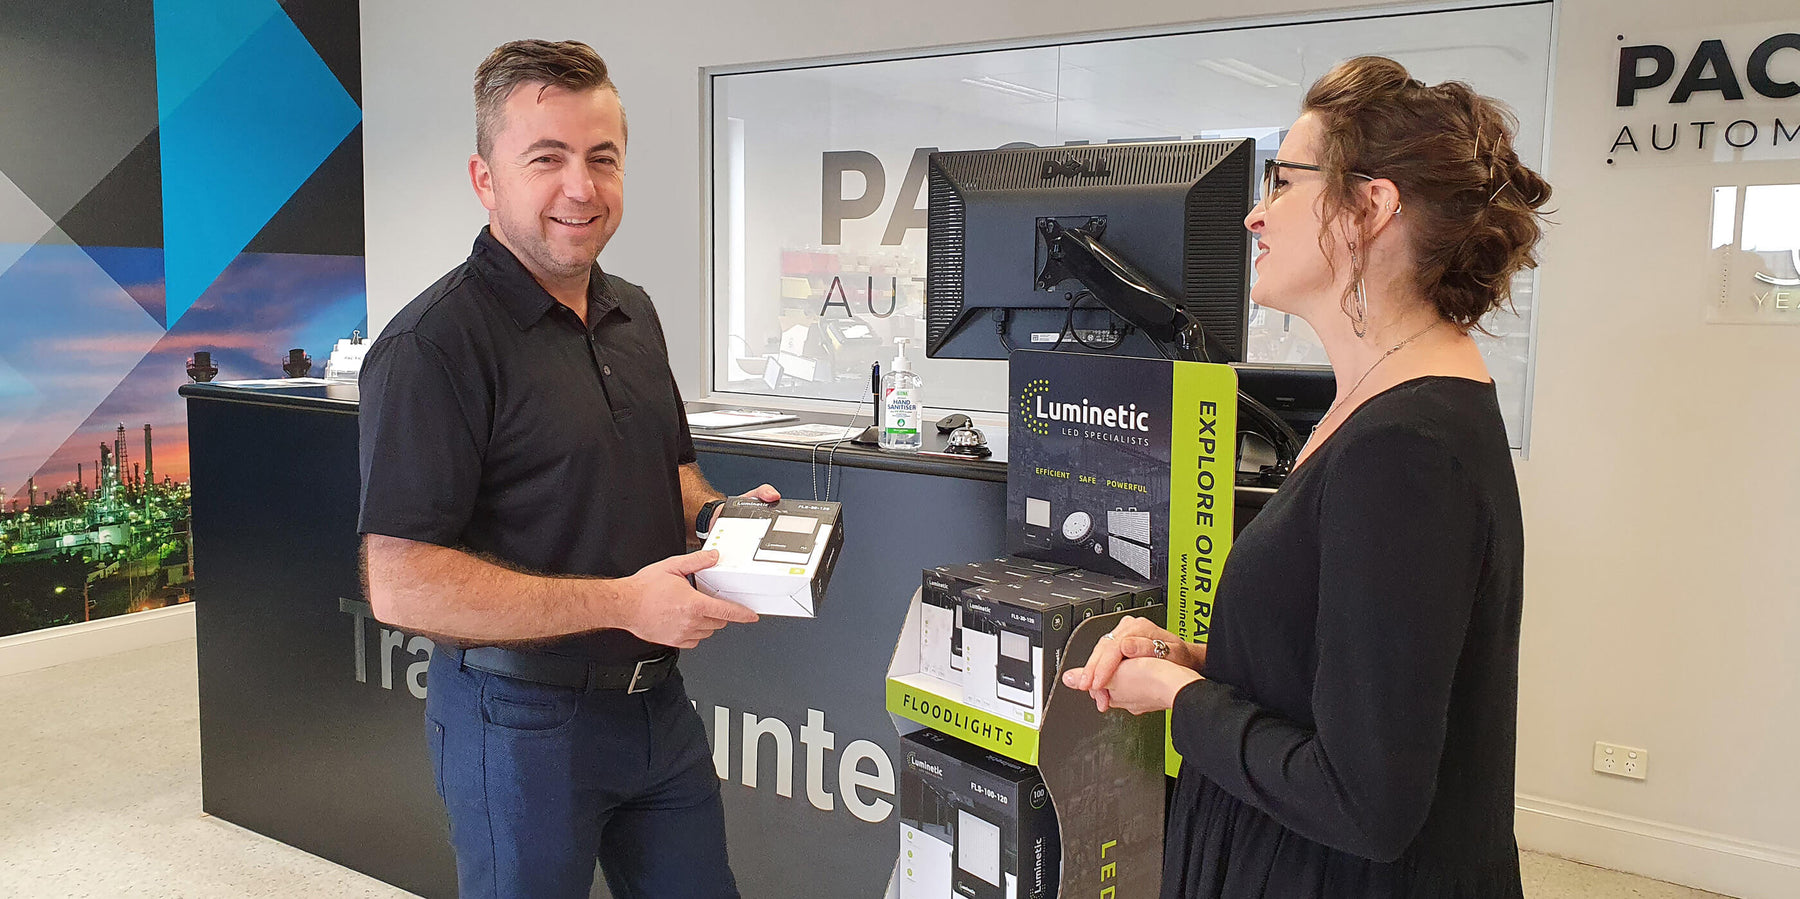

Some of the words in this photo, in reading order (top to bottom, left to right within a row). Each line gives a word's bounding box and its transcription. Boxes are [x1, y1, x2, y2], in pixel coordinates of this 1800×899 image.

[1616, 33, 1800, 107] PAC
[1609, 118, 1800, 153] AUTOM
[1041, 158, 1111, 180] DELL
[1753, 291, 1800, 309] YE
[1036, 395, 1149, 432] Luminetic
[1062, 427, 1079, 437] LED
[1084, 430, 1149, 446] SPECIALISTS
[1035, 467, 1070, 479] EFFICIENT
[1079, 475, 1097, 485] SAFE
[1106, 479, 1148, 493] POWERFUL
[1196, 400, 1217, 528] EXPLORE
[1194, 535, 1213, 593] OUR
[903, 693, 1013, 746] FLOODLIGHTS
[911, 756, 943, 777] Luminetic
[1033, 789, 1045, 799] 100
[1033, 837, 1042, 894] Luminetic
[1101, 840, 1117, 899] LED
